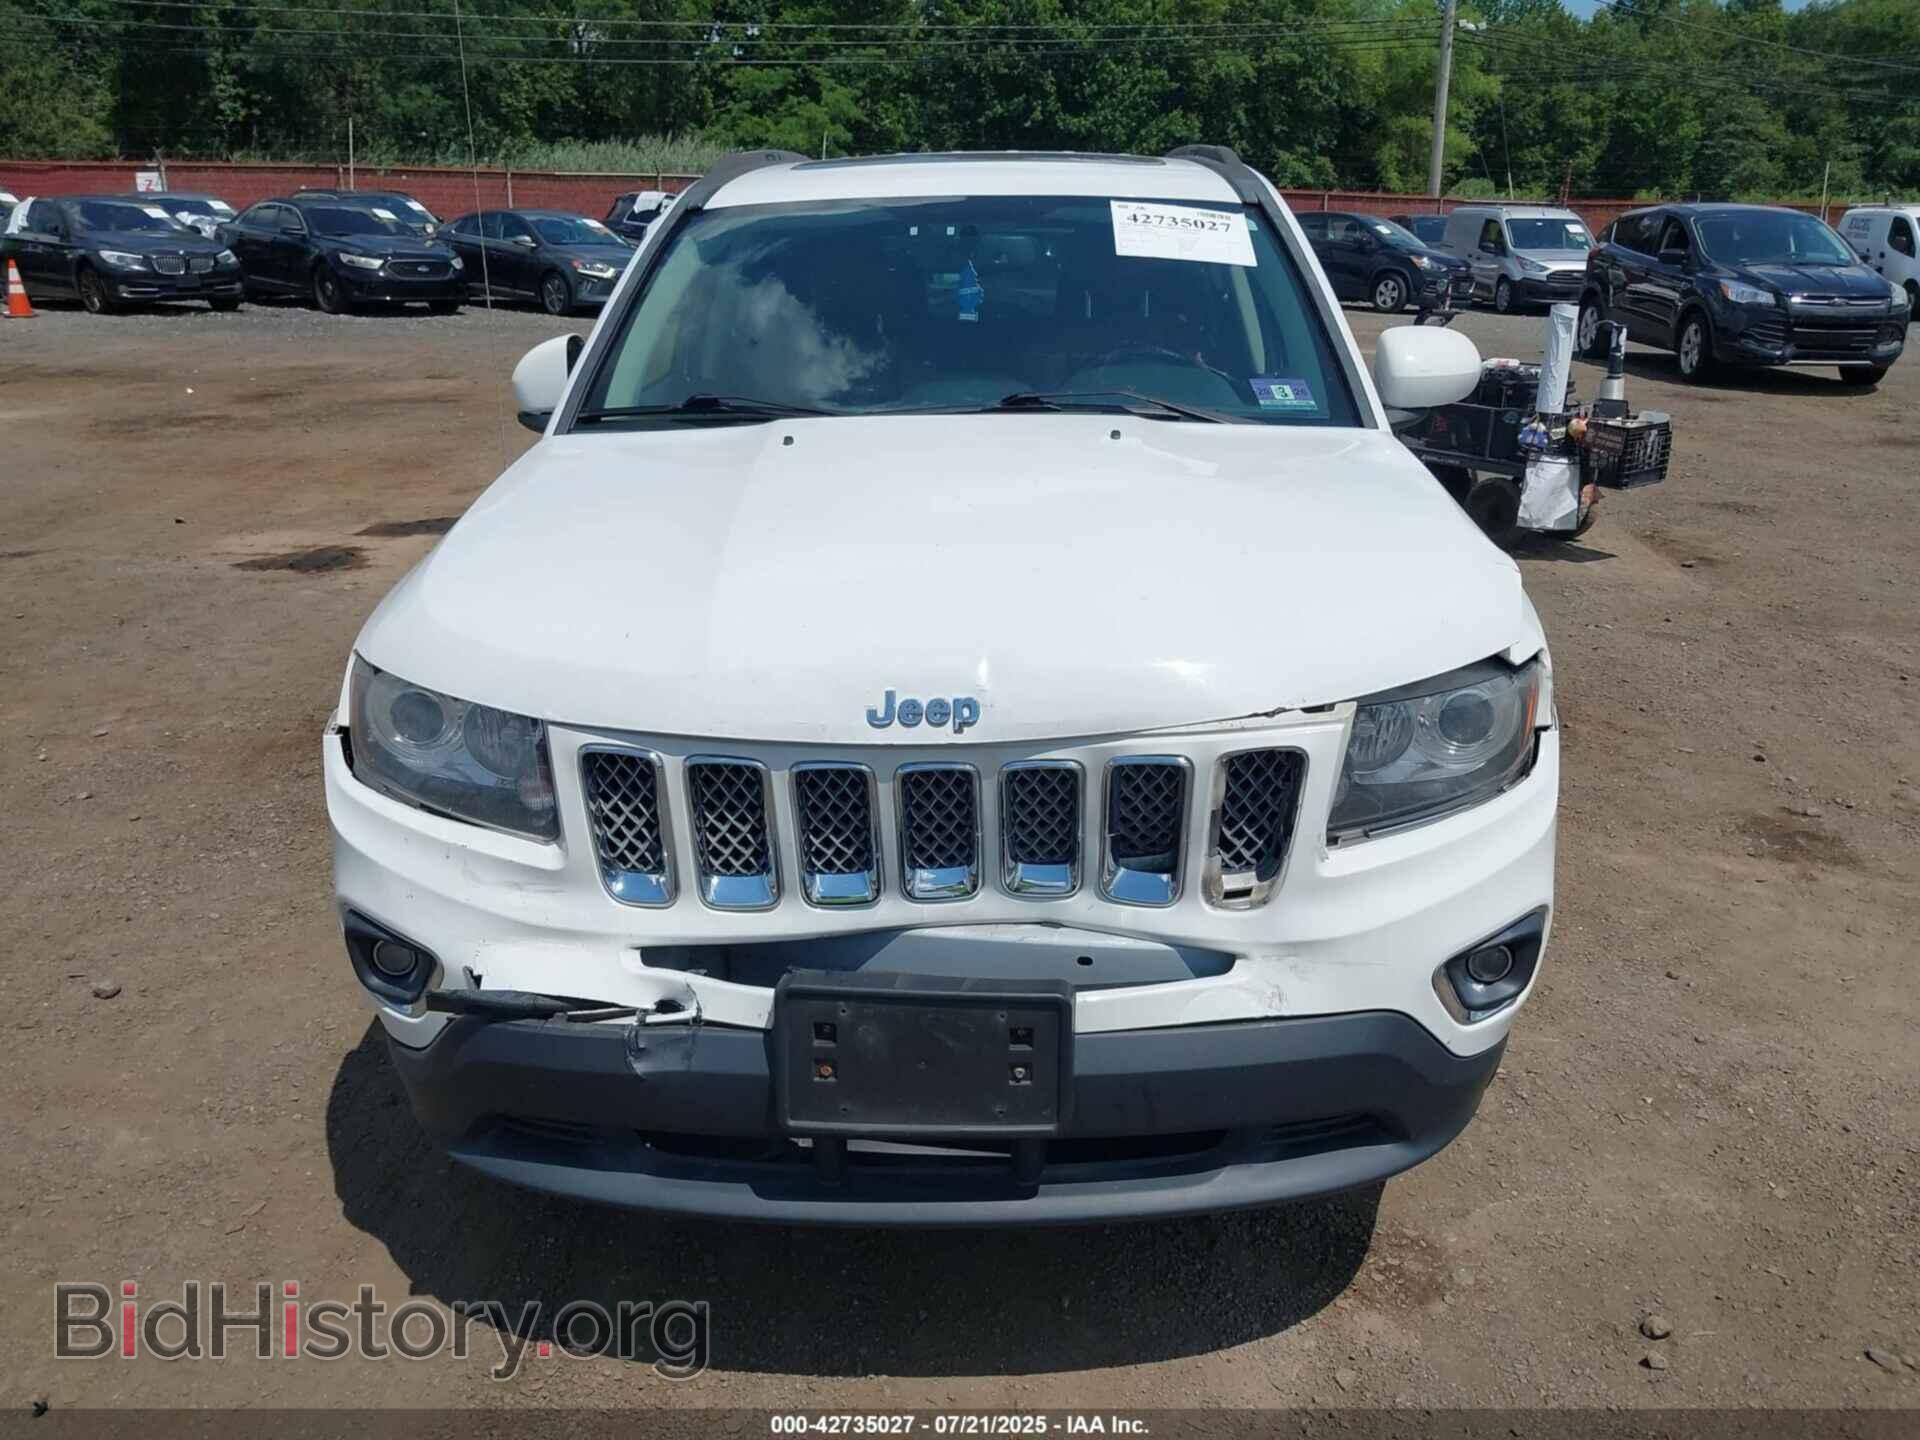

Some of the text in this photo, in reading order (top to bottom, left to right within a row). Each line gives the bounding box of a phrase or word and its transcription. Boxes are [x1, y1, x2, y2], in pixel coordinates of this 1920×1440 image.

[1126, 213, 1231, 233] 42735027
[1278, 386, 1290, 398] 3
[866, 689, 981, 734] Jeep
